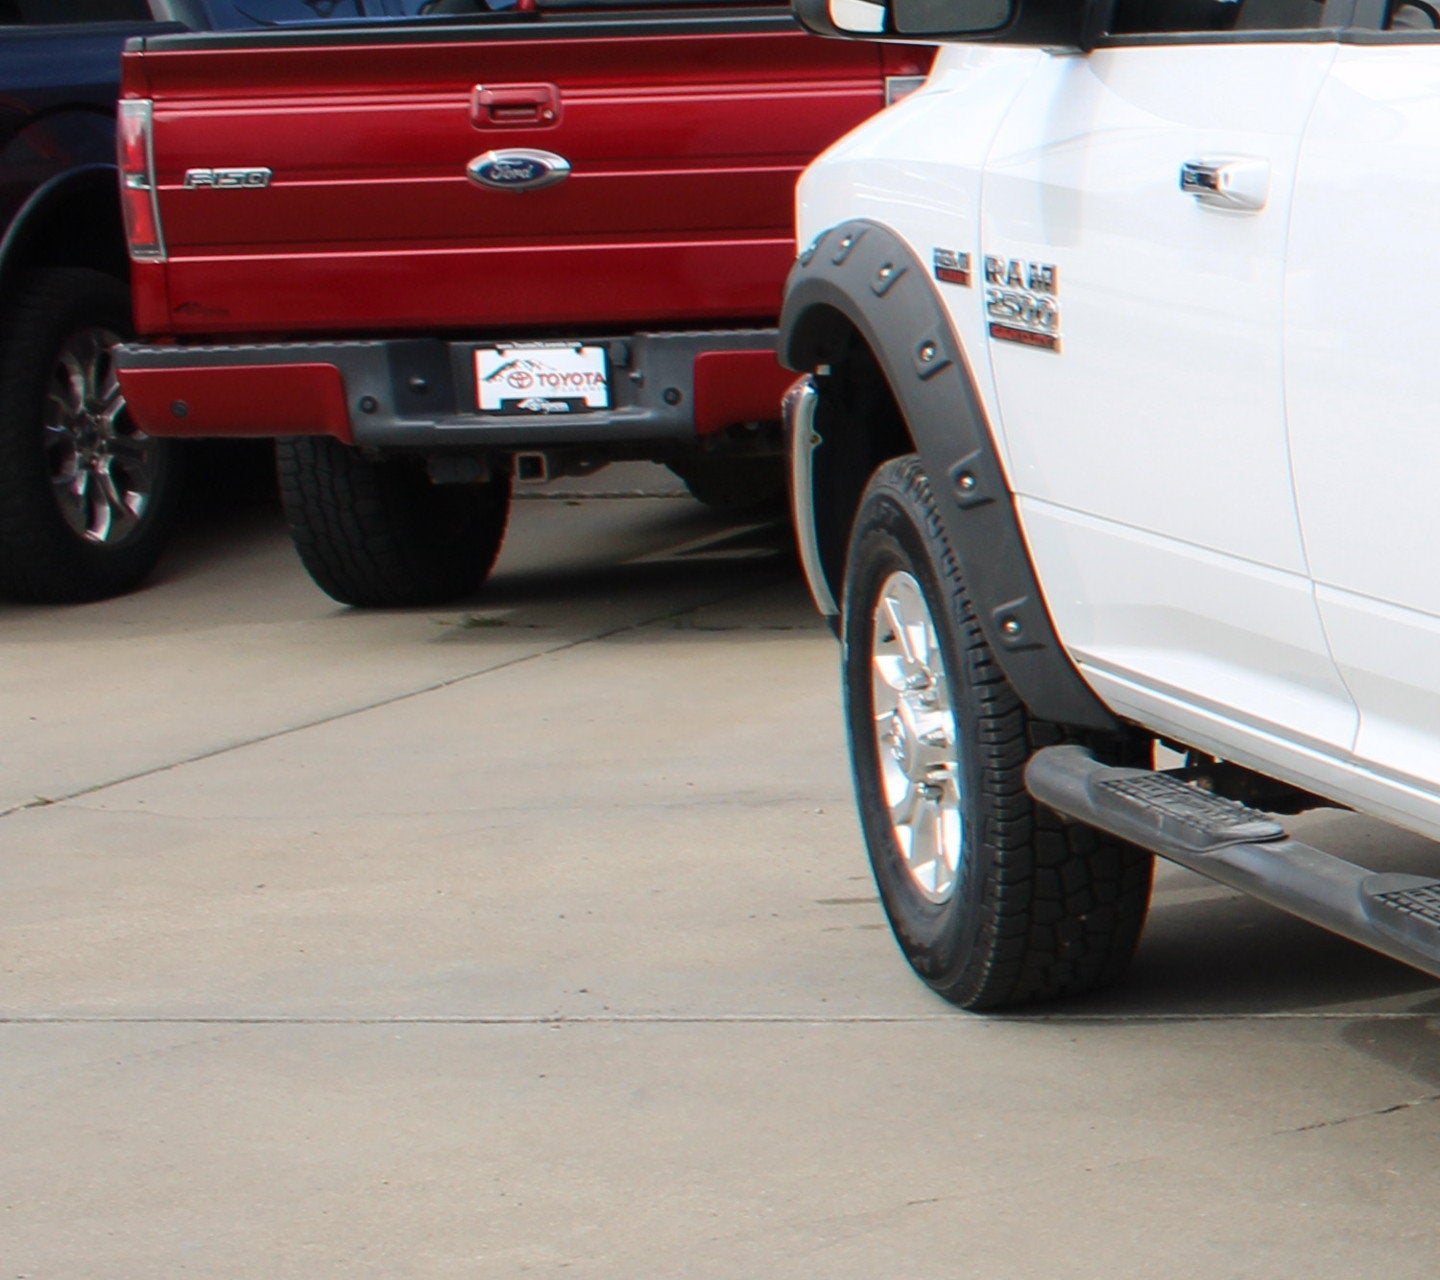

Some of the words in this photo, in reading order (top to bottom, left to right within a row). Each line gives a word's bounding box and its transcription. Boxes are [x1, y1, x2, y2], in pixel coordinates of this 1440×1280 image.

[184, 167, 273, 189] F-150
[490, 160, 533, 180] Ford
[984, 255, 1059, 296] RAM
[985, 287, 1061, 331] 2500
[535, 372, 605, 387] TOYOTA
